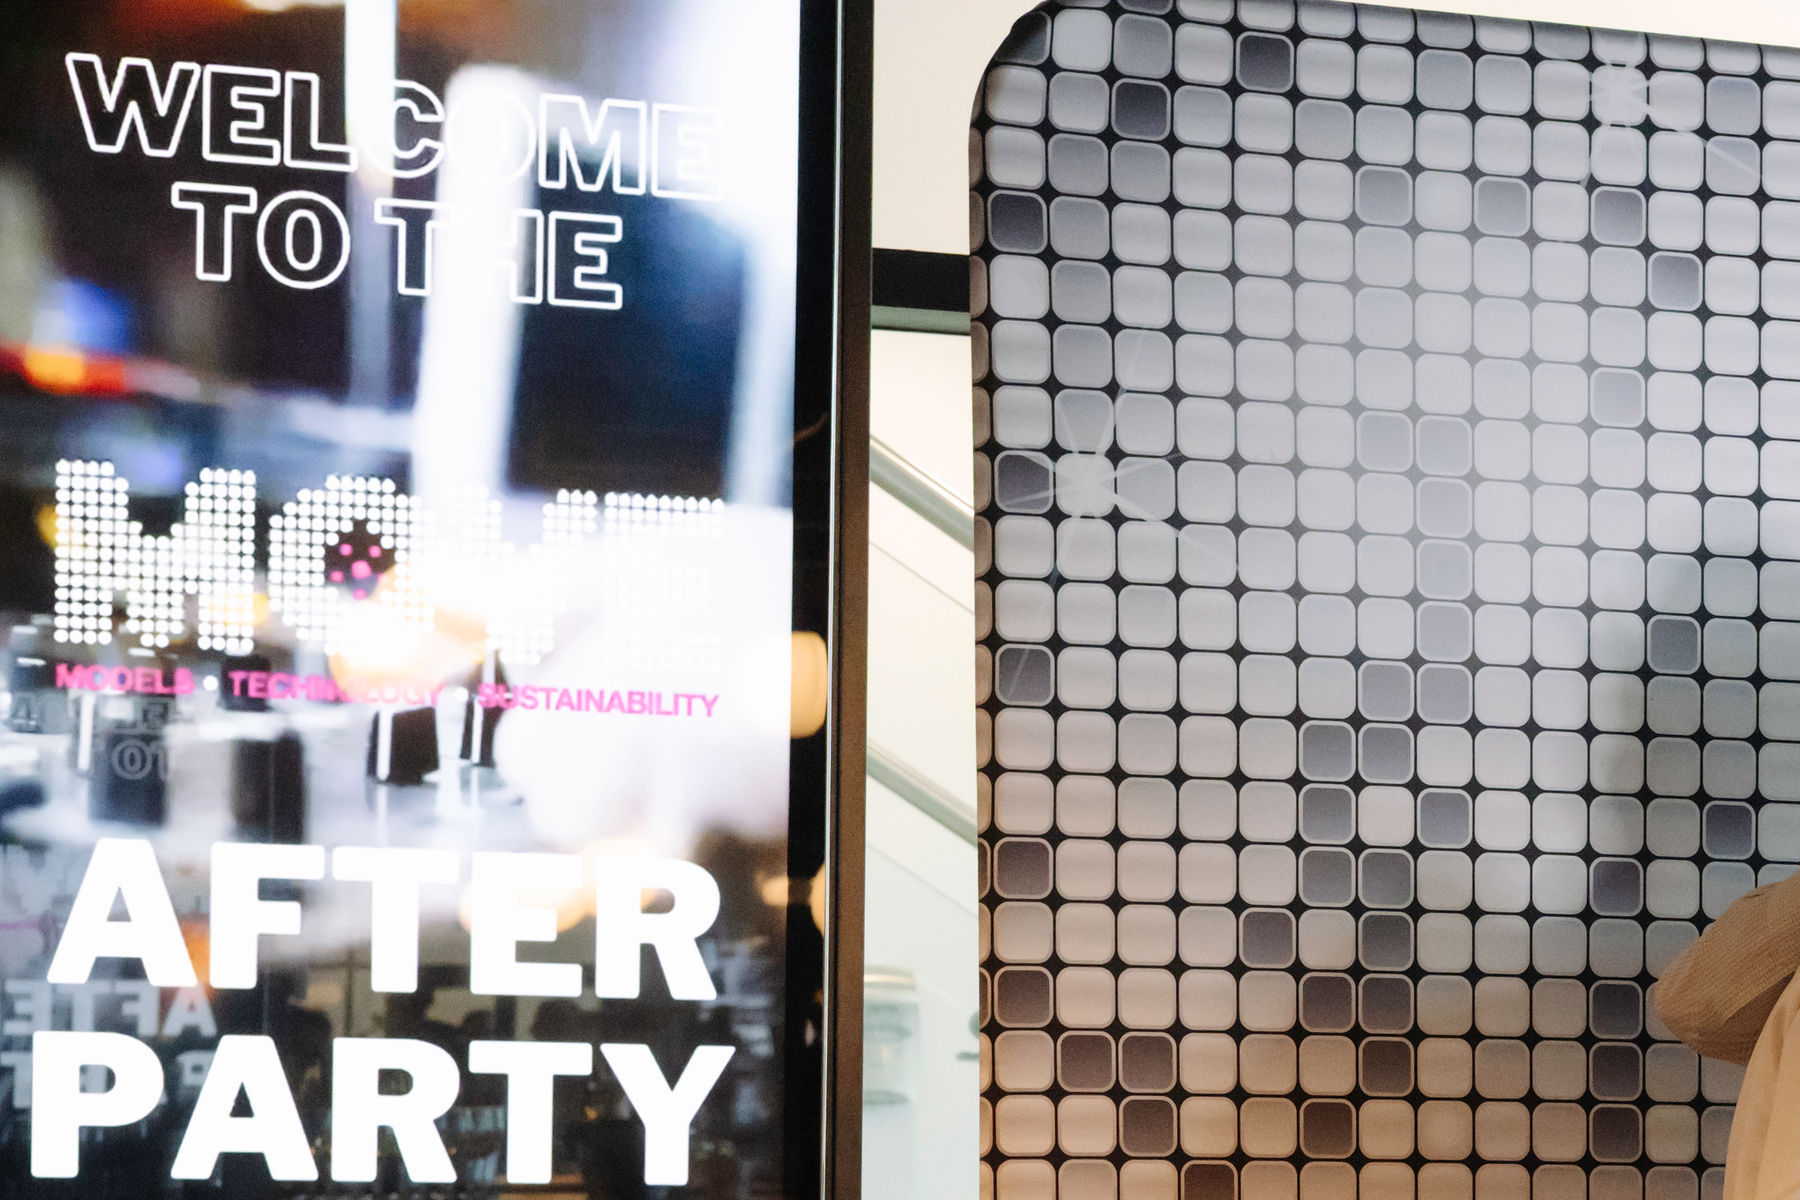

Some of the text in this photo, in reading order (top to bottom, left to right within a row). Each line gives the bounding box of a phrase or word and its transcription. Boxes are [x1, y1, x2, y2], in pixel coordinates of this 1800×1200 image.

[65, 52, 726, 201] WELCOME
[171, 181, 623, 310] TO THE
[54, 459, 724, 673] MOVE
[55, 663, 720, 718] MODELS TECHNLOGY SUSTAINABILITY
[46, 838, 721, 1001] AFTER
[30, 1031, 737, 1187] PARTY
